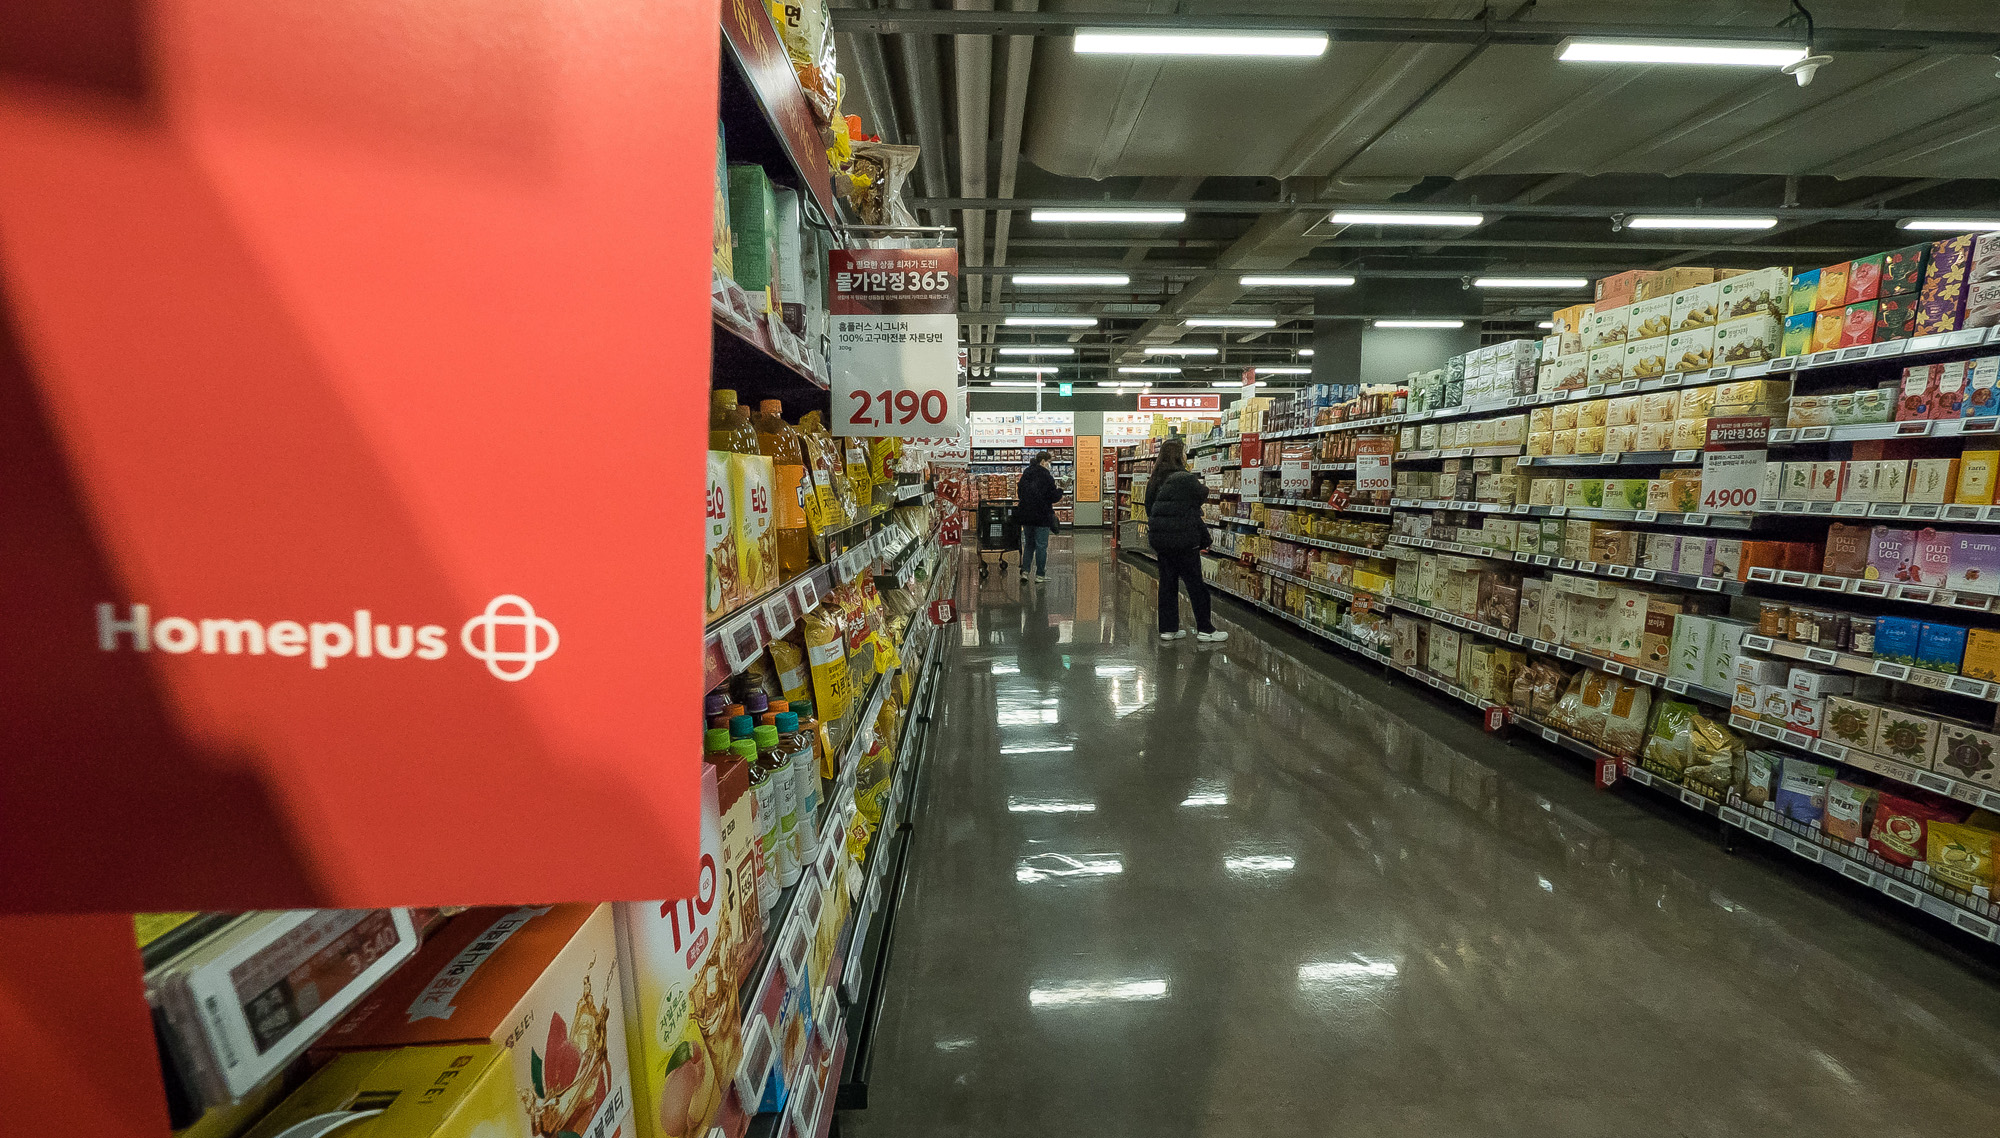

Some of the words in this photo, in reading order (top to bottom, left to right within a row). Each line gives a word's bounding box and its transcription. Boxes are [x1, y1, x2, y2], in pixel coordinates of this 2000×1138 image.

[785, 5, 800, 27] 면
[880, 260, 894, 269] 상품
[896, 260, 919, 269] 최저가
[920, 260, 938, 269] 도전!
[836, 271, 905, 292] 물가안정
[908, 271, 949, 291] 365
[839, 322, 872, 332] 홈플러스
[874, 322, 908, 332] 시그니처
[839, 334, 864, 342] 100%
[865, 333, 907, 343] 고구마전분
[909, 333, 943, 343] 자른당면
[849, 389, 948, 428] 2,190
[1710, 428, 1746, 441] 물가안정
[1746, 427, 1767, 439] 365
[1243, 478, 1257, 486] 1+1
[1283, 478, 1309, 488] 9,990
[1360, 478, 1389, 488] 15,900
[941, 483, 958, 498] 1+1
[751, 486, 768, 514] 티오
[1333, 493, 1346, 504] 1+1
[1704, 488, 1757, 509] 4,900
[943, 529, 959, 541] 1+1
[1836, 536, 1859, 545] our
[1835, 543, 1856, 553] tea
[1878, 541, 1902, 551] our
[1925, 544, 1951, 554] our
[1878, 548, 1900, 559] tea
[1925, 552, 1948, 563] tea
[95, 602, 448, 669] Homeplus
[660, 853, 717, 954] TIO
